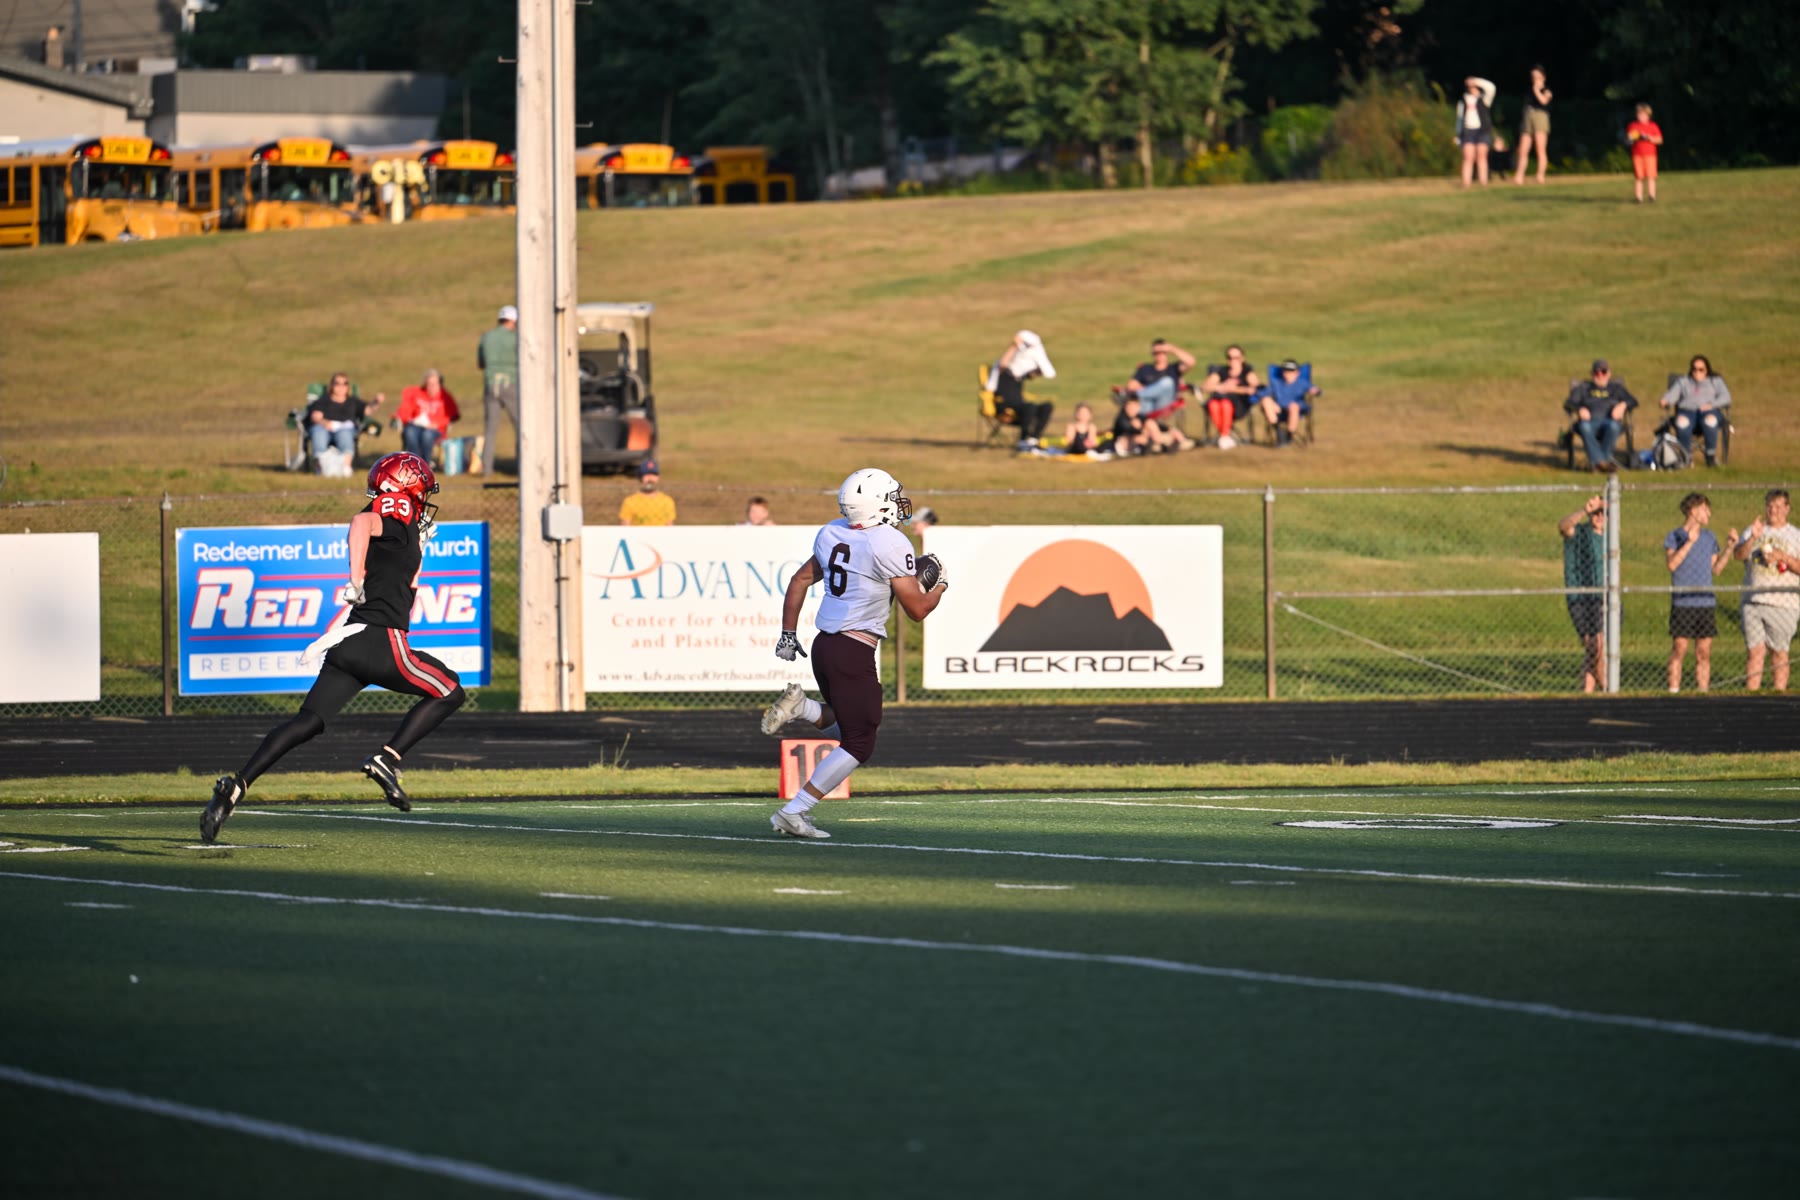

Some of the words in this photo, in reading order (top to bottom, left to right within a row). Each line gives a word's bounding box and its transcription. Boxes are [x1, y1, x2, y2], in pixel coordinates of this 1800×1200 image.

[382, 497, 411, 517] 23
[193, 541, 300, 562] Redeemer
[306, 538, 350, 560] Luth
[421, 535, 480, 557] hurch
[599, 538, 822, 599] ADVANC
[828, 543, 851, 597] 6
[905, 553, 915, 571] 6
[190, 567, 323, 629] RED
[325, 584, 482, 633] ZNE
[611, 612, 676, 627] Center
[686, 612, 714, 627] for
[724, 610, 815, 626] Orthod
[631, 633, 665, 648] and
[675, 633, 736, 648] Plastic
[945, 655, 1205, 674] BLACKROCKS
